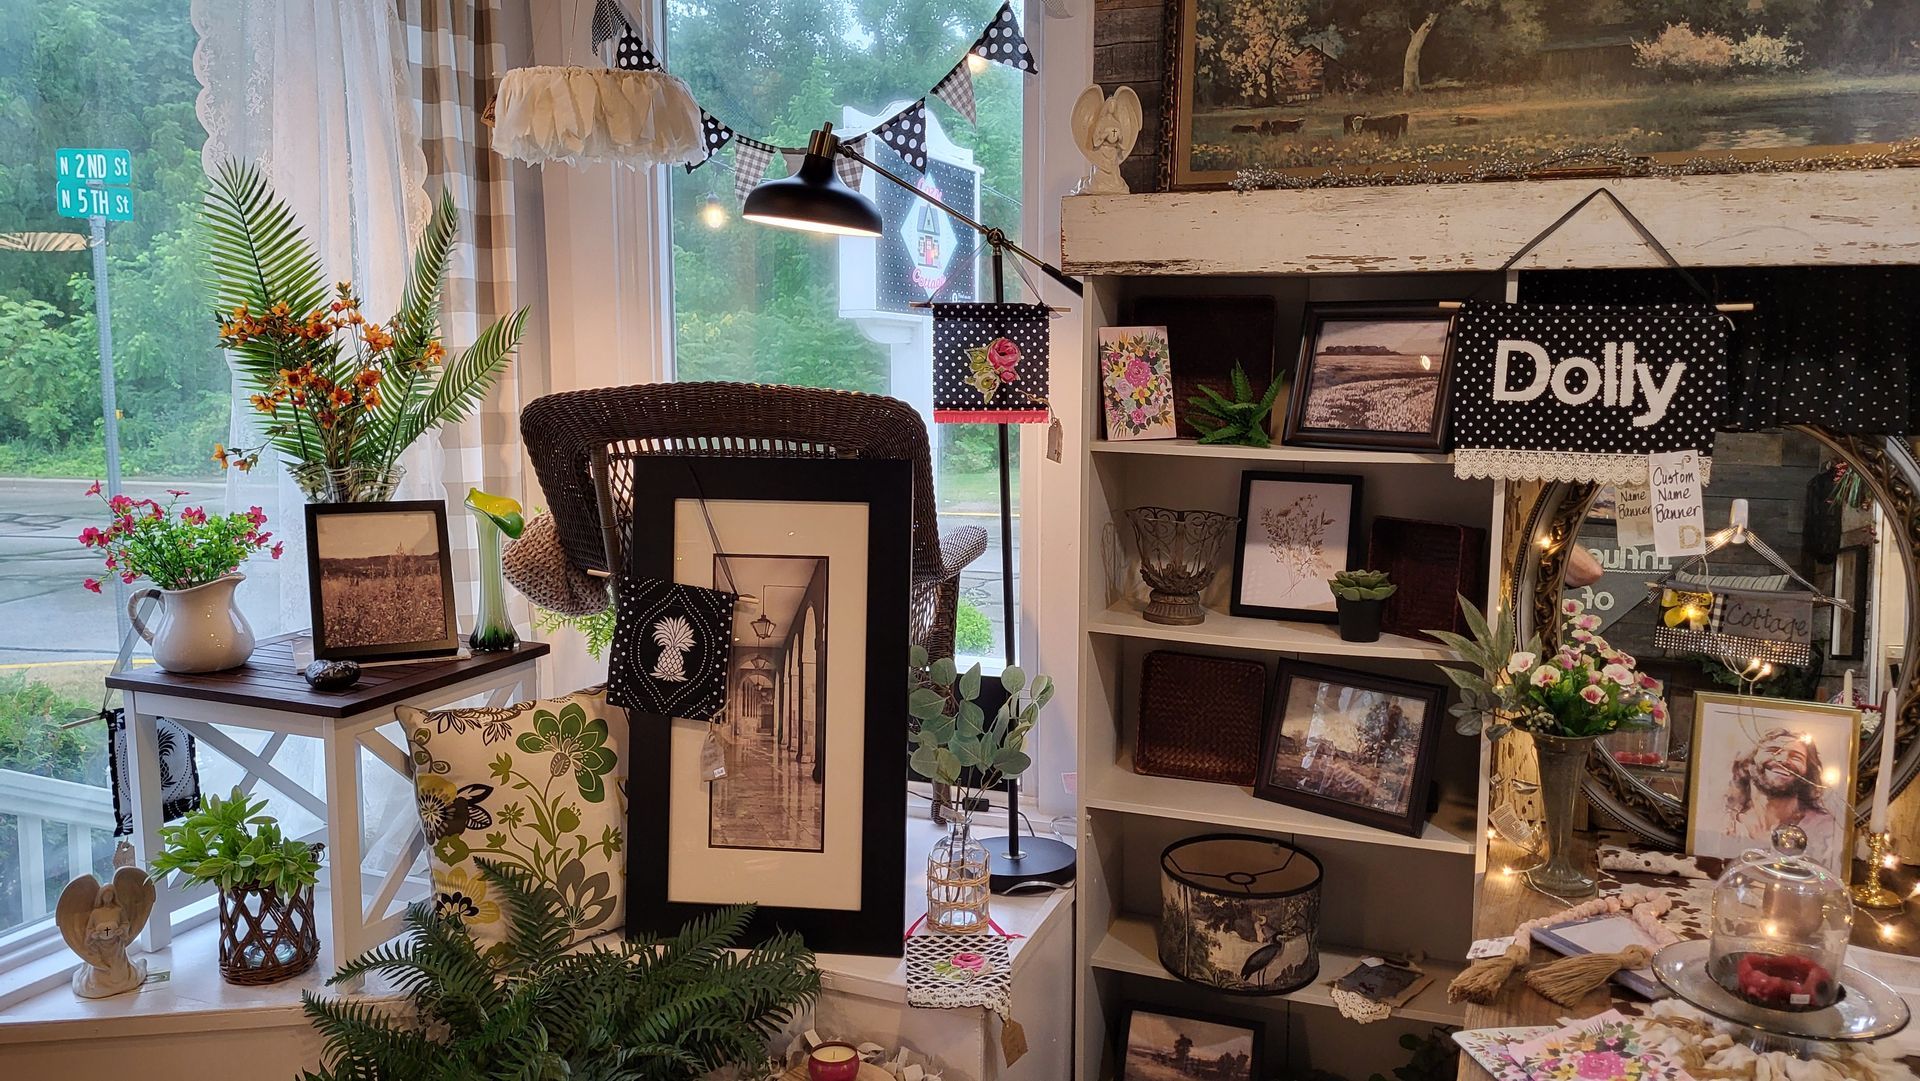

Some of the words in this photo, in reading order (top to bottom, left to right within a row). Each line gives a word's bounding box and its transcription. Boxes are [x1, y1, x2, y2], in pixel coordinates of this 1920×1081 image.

[60, 156, 69, 176] N
[75, 153, 107, 179] 2ND
[114, 157, 128, 176] St
[61, 189, 71, 209] N
[77, 188, 110, 215] 5TH
[116, 195, 130, 214] St
[1493, 339, 1687, 427] Dolly
[1653, 466, 1695, 487] Custom
[1620, 490, 1647, 502] Name
[1657, 487, 1692, 502] Name
[1654, 503, 1701, 523] Banner
[1726, 603, 1808, 640] Cottage
